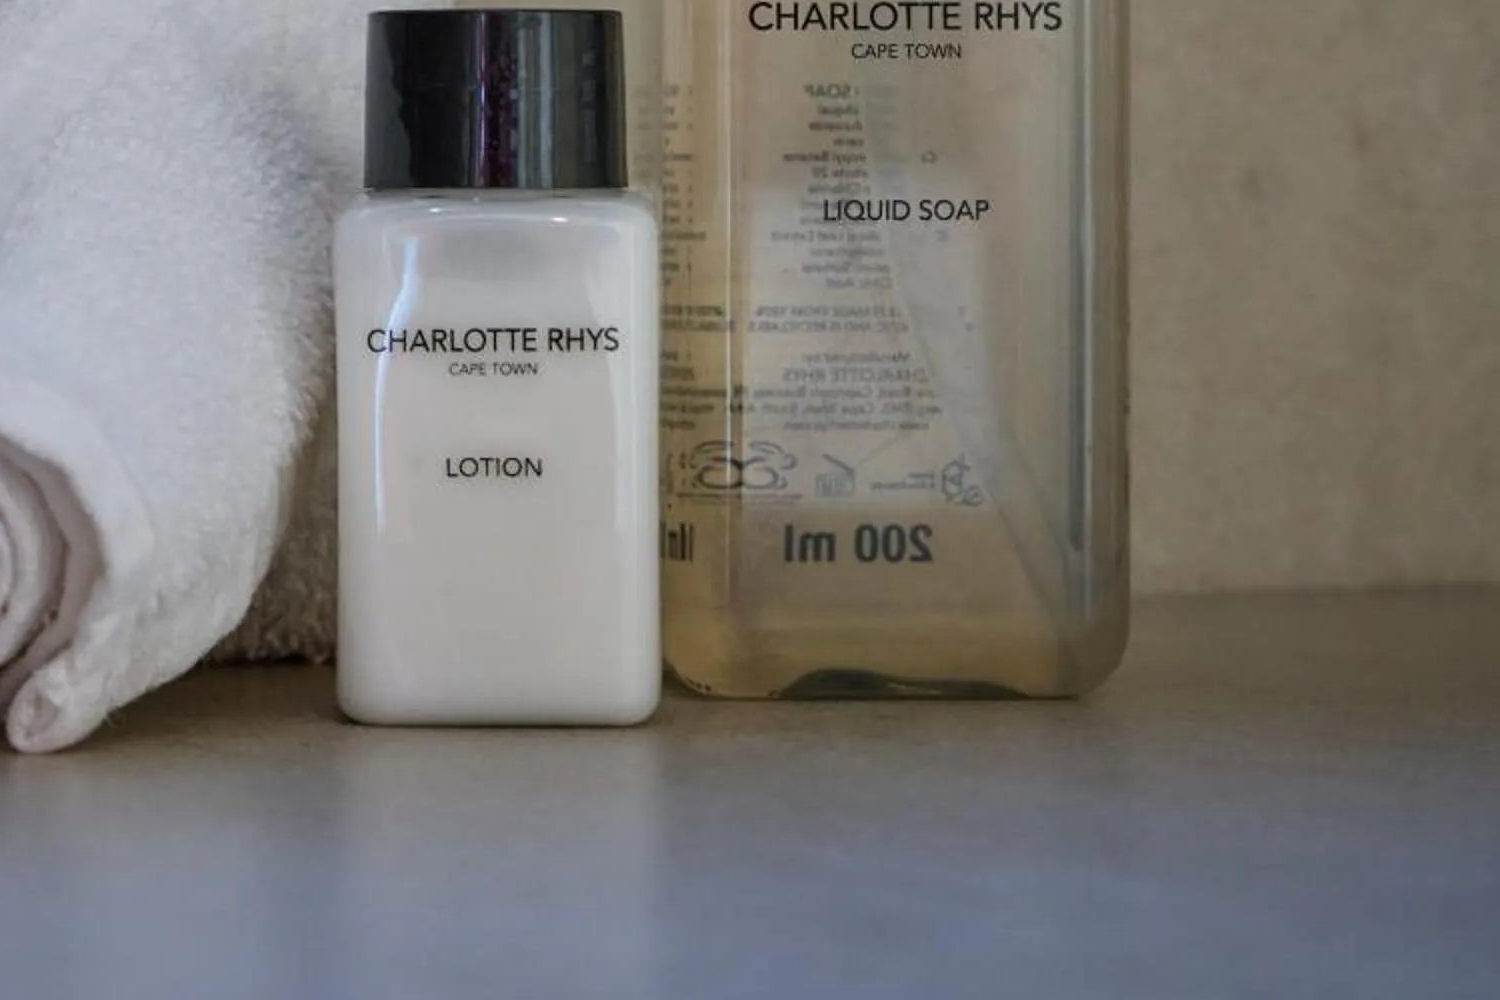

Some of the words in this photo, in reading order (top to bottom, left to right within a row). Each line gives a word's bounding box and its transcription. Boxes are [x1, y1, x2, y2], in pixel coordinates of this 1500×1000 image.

[748, 1, 962, 31] CHARLOTTE
[974, 1, 1062, 31] RHYS
[851, 43, 898, 59] CAPE
[903, 43, 962, 59] TOWN
[823, 199, 911, 222] LIQUID
[919, 199, 989, 221] SOAP
[366, 327, 538, 353] CHARLOTTE
[547, 327, 620, 353] RHYS
[449, 362, 486, 377] CAPE
[492, 362, 538, 377] TOWN
[446, 457, 542, 478] LOTION
